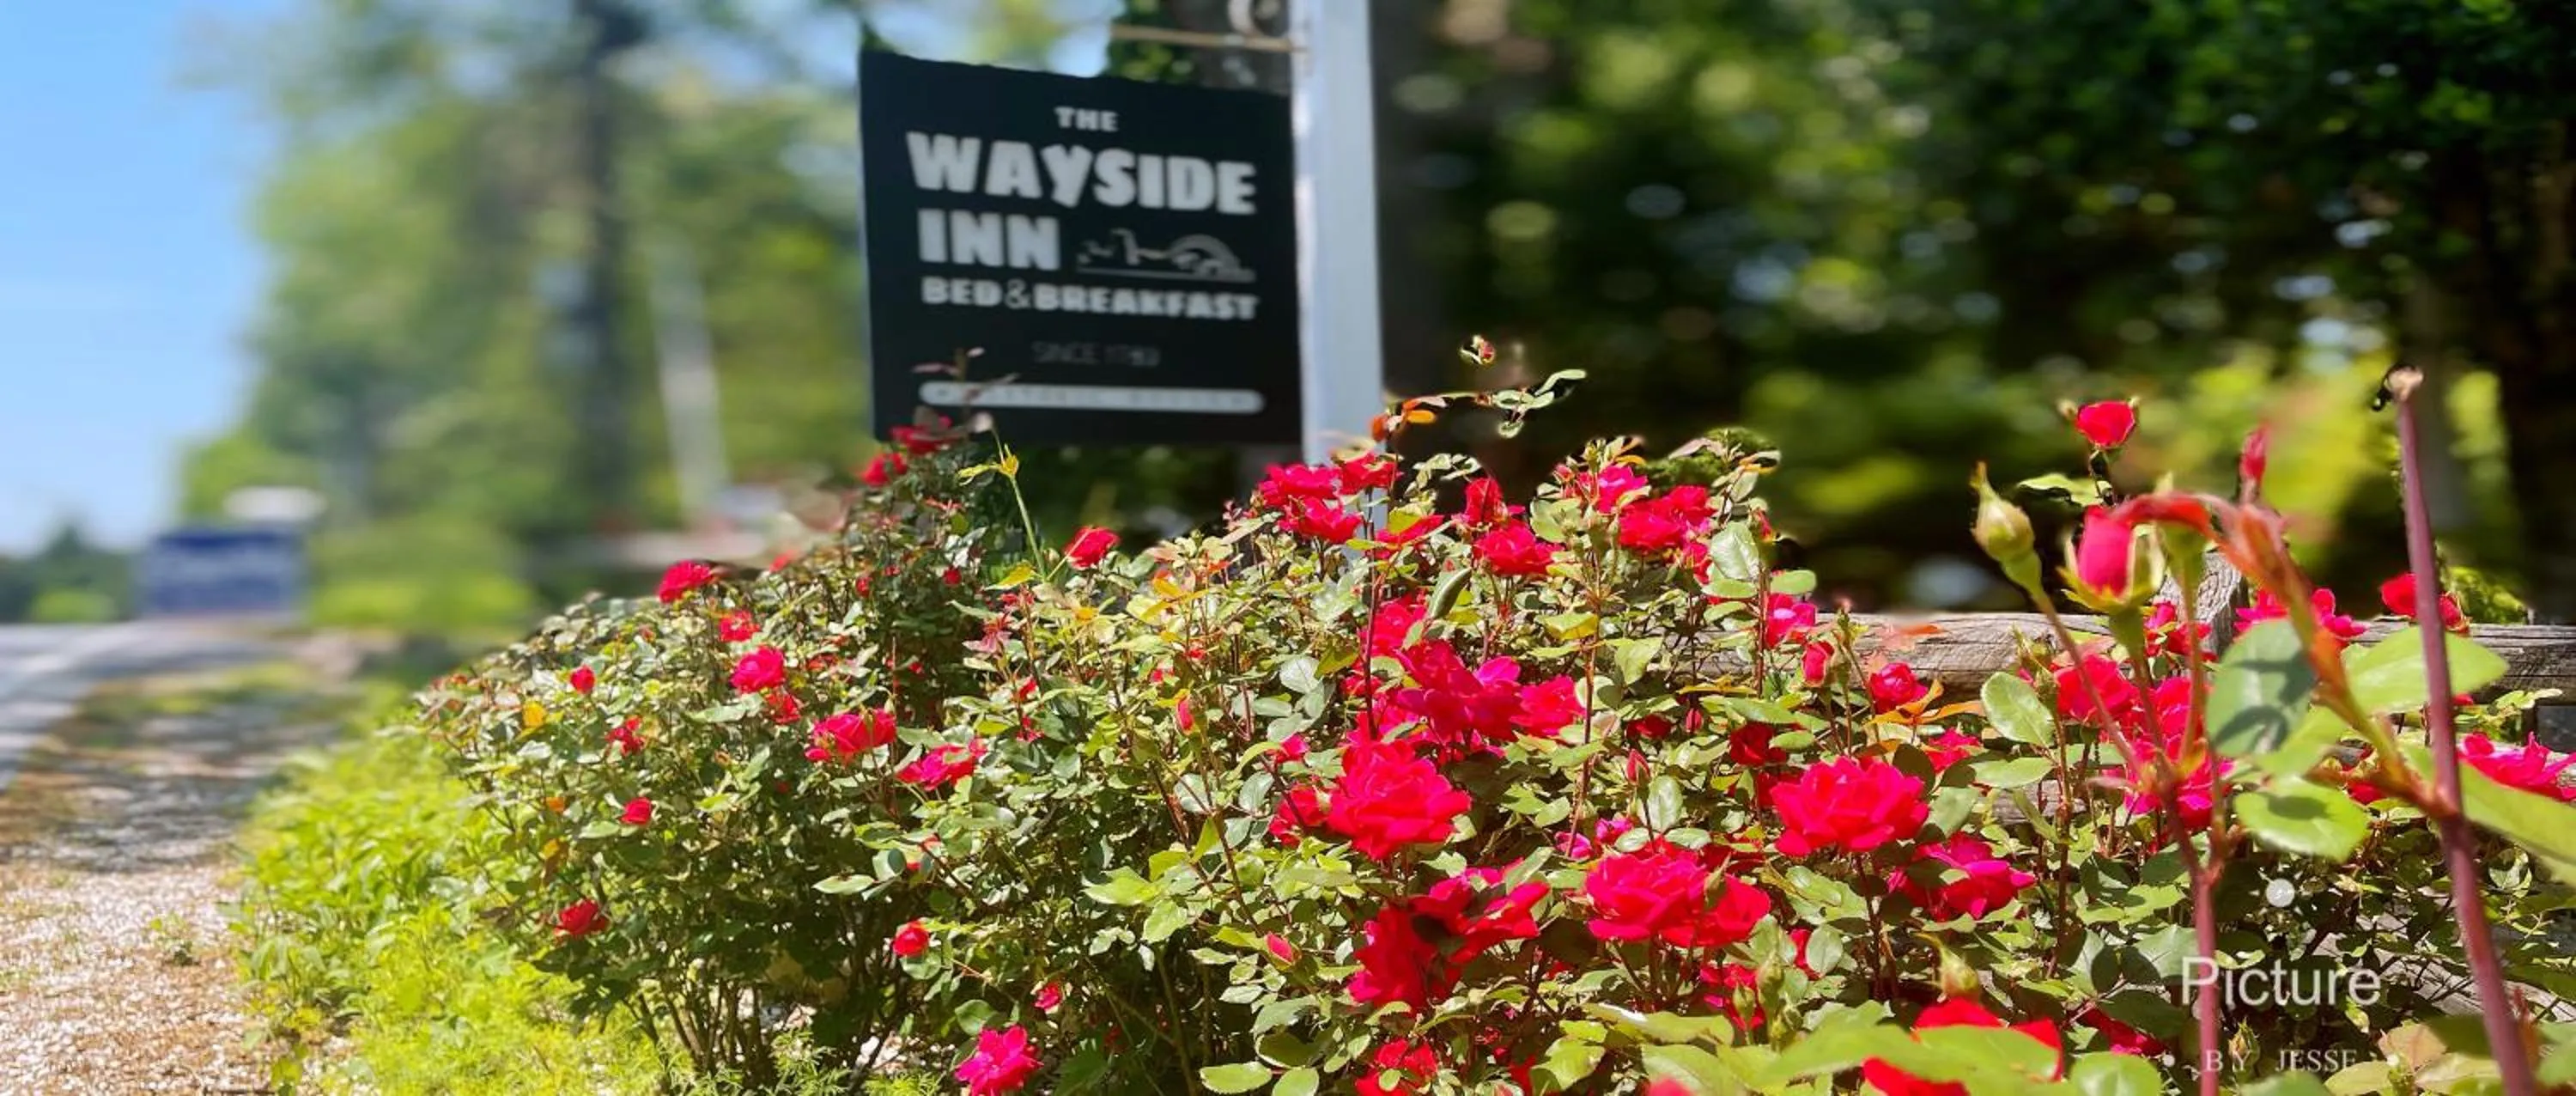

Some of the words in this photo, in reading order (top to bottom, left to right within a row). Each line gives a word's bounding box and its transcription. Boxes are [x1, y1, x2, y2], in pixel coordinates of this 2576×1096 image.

[1054, 106, 1118, 132] THE
[905, 131, 1256, 215] WAYSIDE
[918, 209, 1060, 271] INN
[1032, 341, 1098, 364] SINCE
